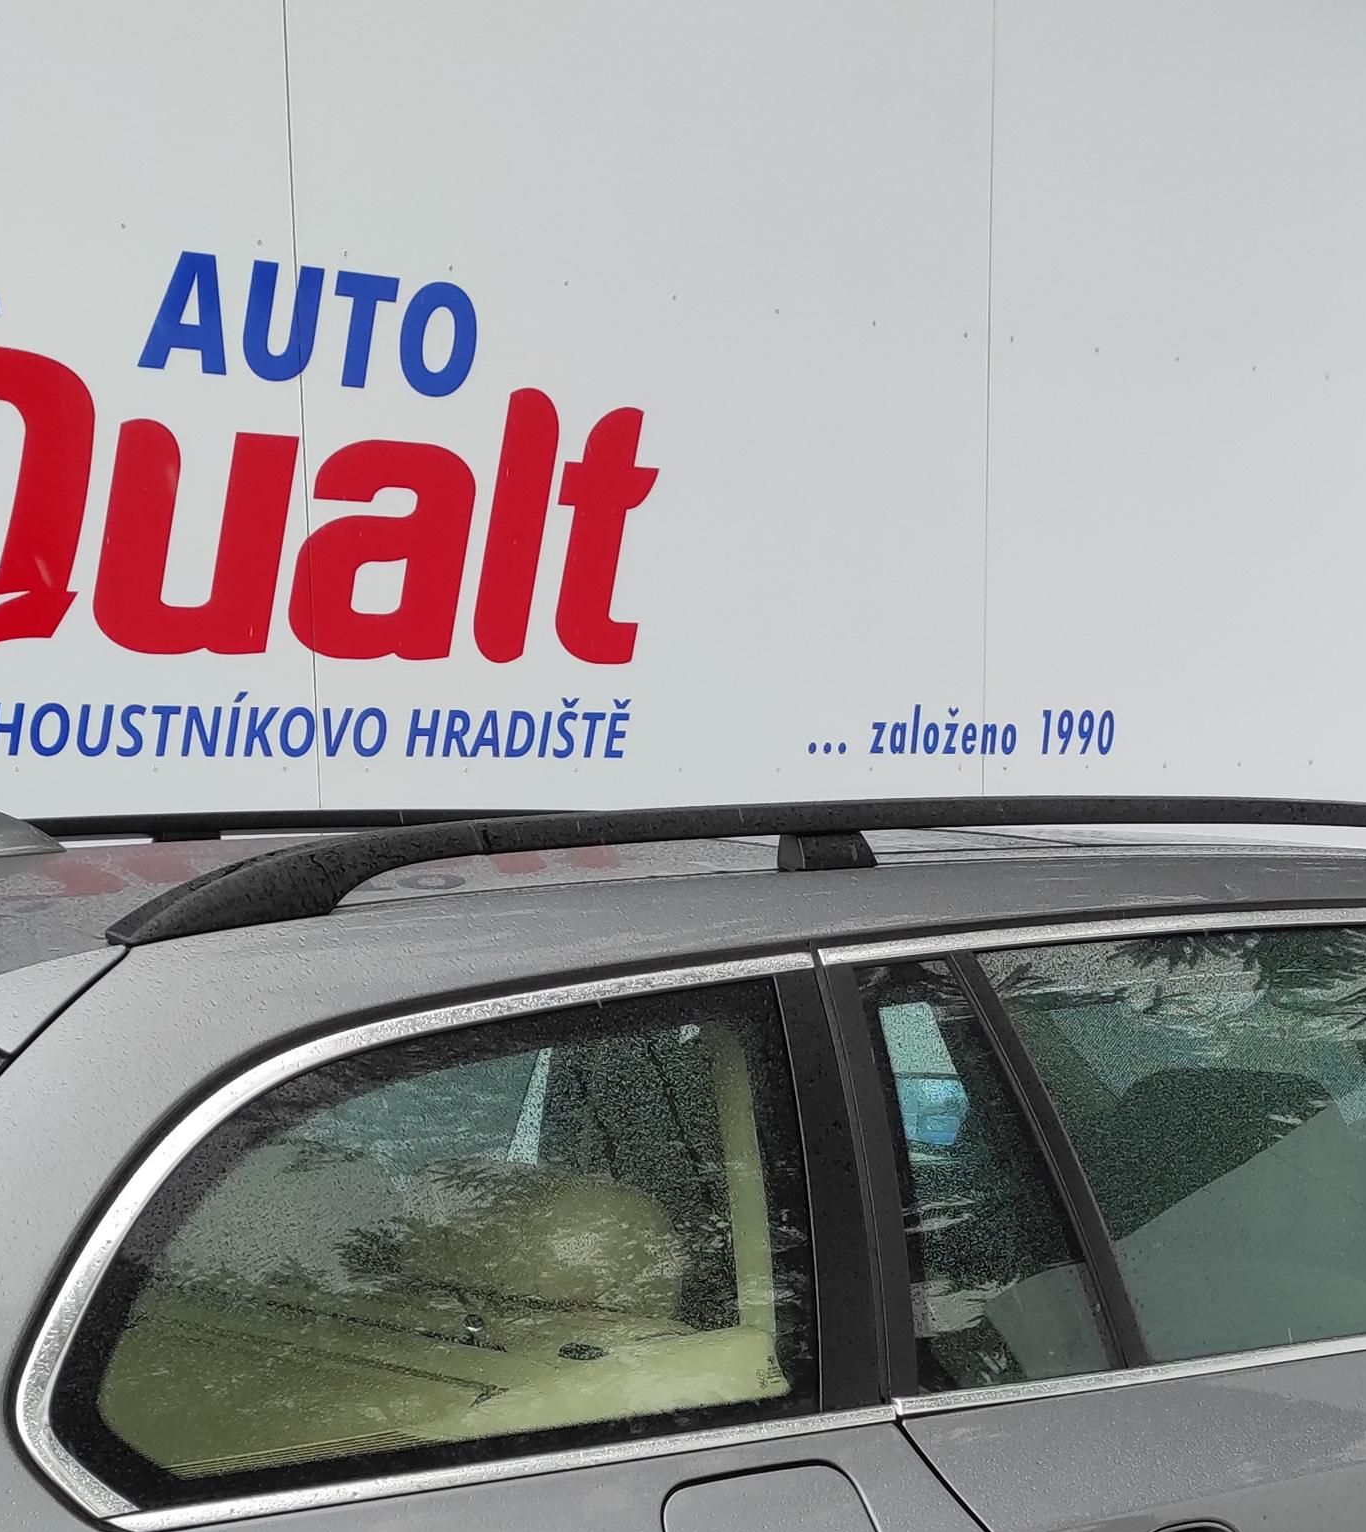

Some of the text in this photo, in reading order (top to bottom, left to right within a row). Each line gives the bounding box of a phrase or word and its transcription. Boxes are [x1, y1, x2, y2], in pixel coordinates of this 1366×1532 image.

[137, 250, 478, 398] AUTO
[405, 699, 631, 759] HRADIŠTĚ
[869, 703, 1018, 755] založeno
[1041, 709, 1116, 755] 1990
